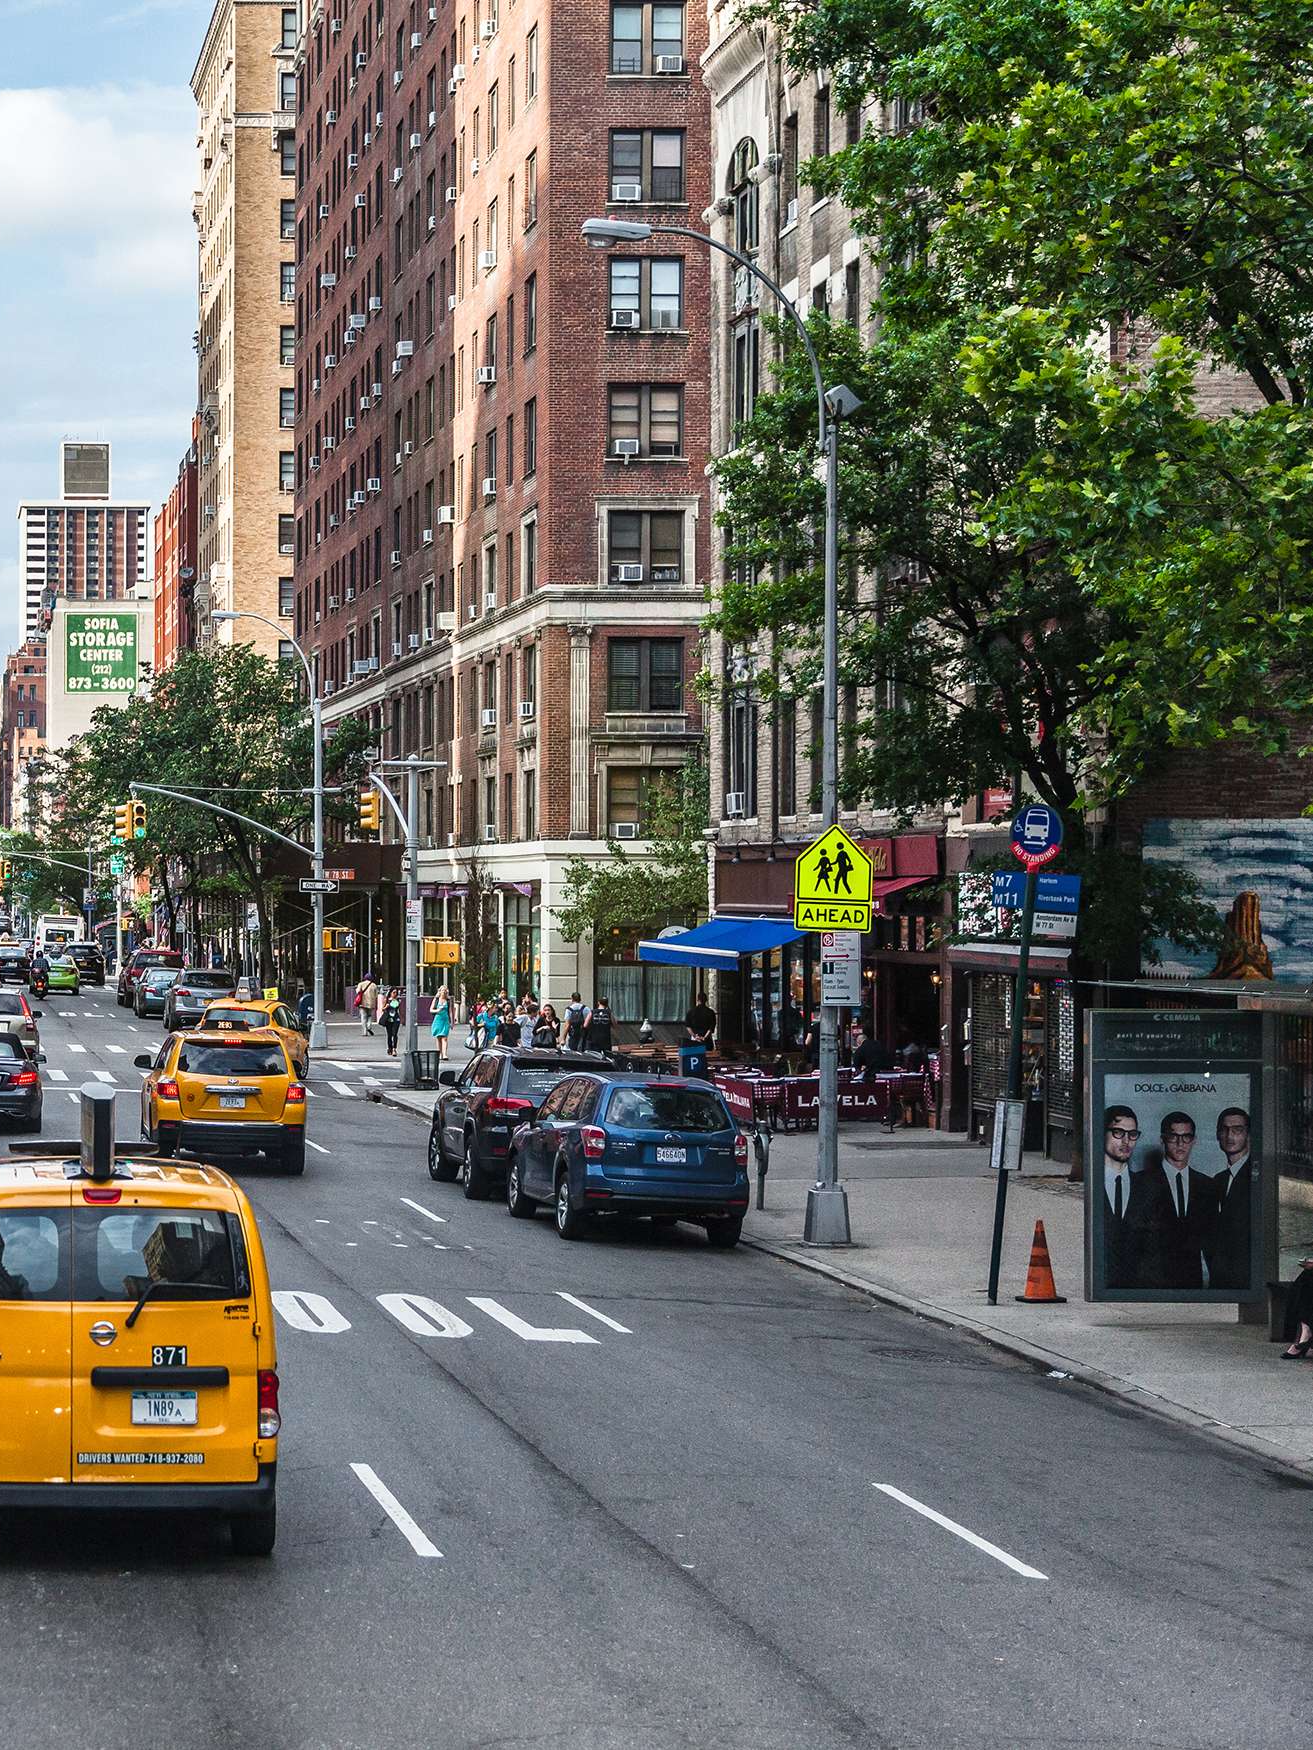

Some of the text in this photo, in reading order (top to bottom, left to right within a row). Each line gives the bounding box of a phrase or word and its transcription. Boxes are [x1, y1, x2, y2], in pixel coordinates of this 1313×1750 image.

[84, 617, 119, 630] SOFIA
[69, 631, 134, 646] STORAGE
[79, 648, 124, 662] CENTER
[91, 663, 112, 676] (212)
[1013, 844, 1056, 863] NO STANDING
[995, 874, 1013, 888] M7
[994, 892, 1018, 906] M11
[802, 908, 865, 924] AHEAD
[690, 1057, 699, 1070] P
[798, 1095, 820, 1107] LA
[153, 1347, 187, 1365] 871
[78, 1453, 112, 1464] DRIVERS
